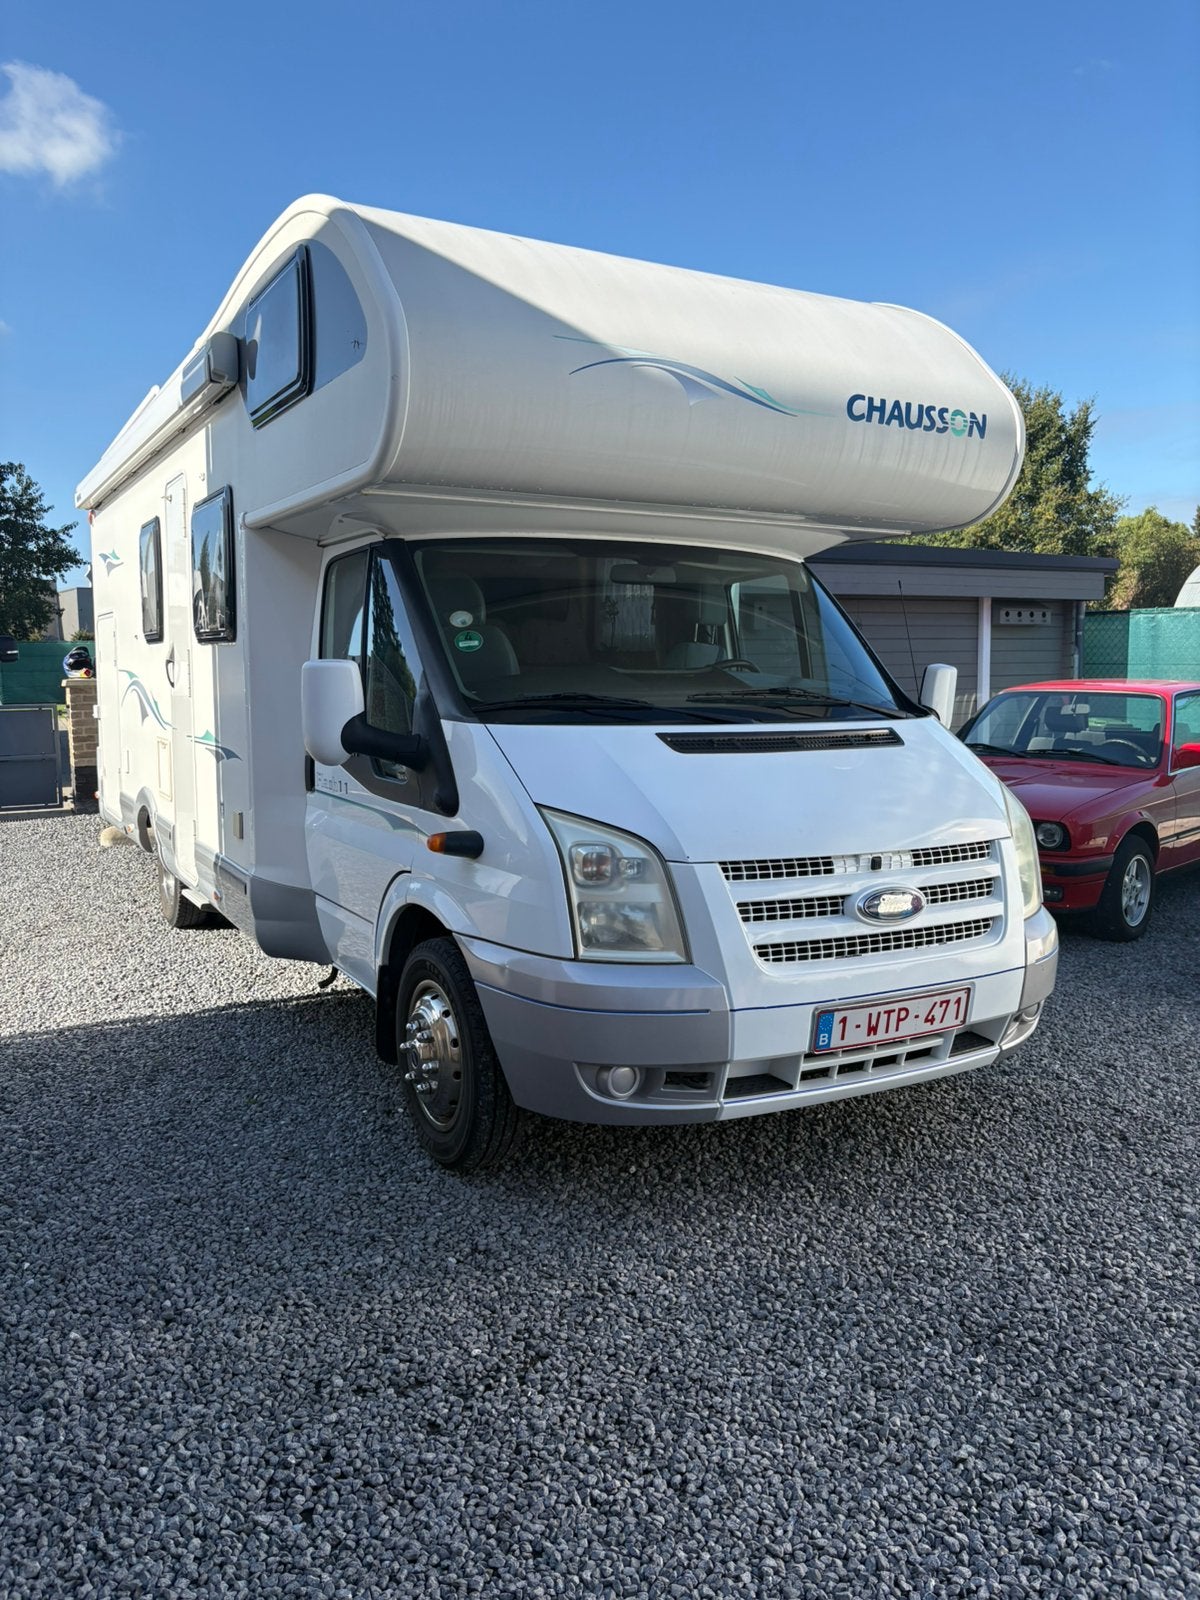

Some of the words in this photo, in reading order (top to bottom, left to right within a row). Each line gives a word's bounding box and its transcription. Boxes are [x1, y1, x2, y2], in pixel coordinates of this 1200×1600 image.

[846, 393, 988, 440] CHAUSSON
[818, 1033, 829, 1046] B
[838, 996, 962, 1041] 1-WTP-471
